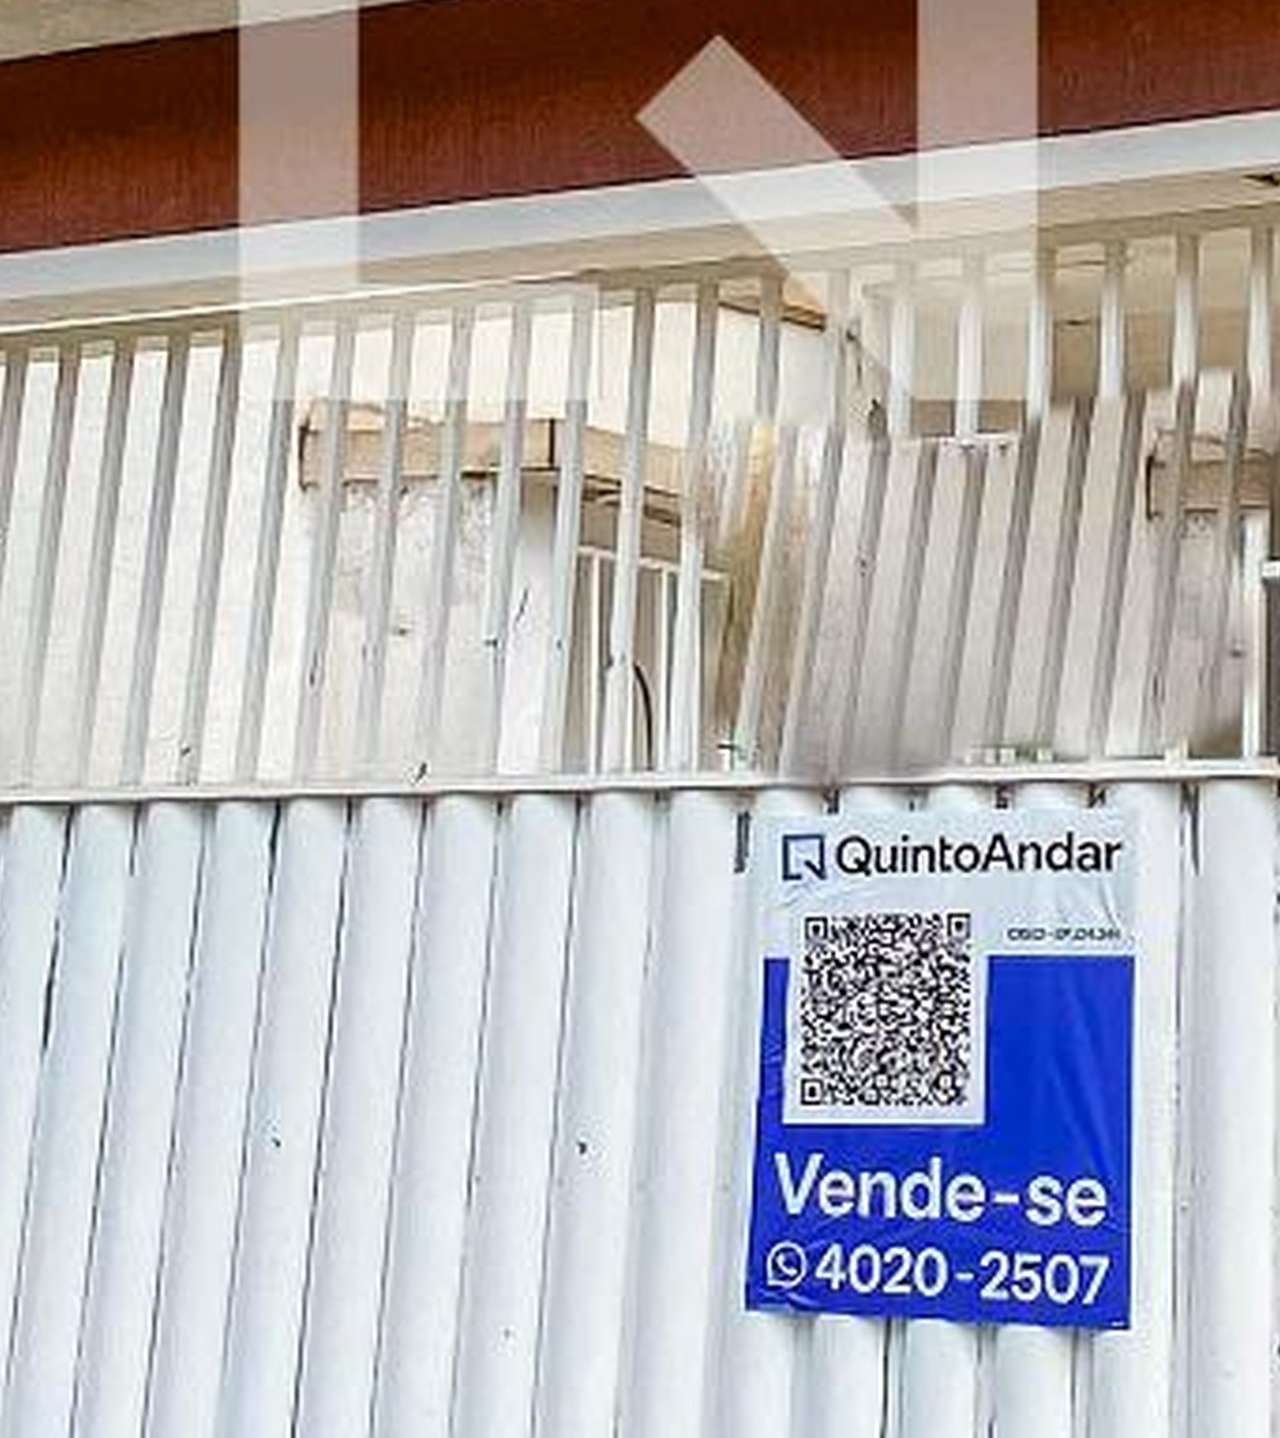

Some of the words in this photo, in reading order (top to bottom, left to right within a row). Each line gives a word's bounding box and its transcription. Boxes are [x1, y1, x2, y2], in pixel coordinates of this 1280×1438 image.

[835, 831, 1123, 876] QuintoAndar
[773, 1152, 1107, 1227] Vende-se
[815, 1242, 1111, 1305] 4020-2507
